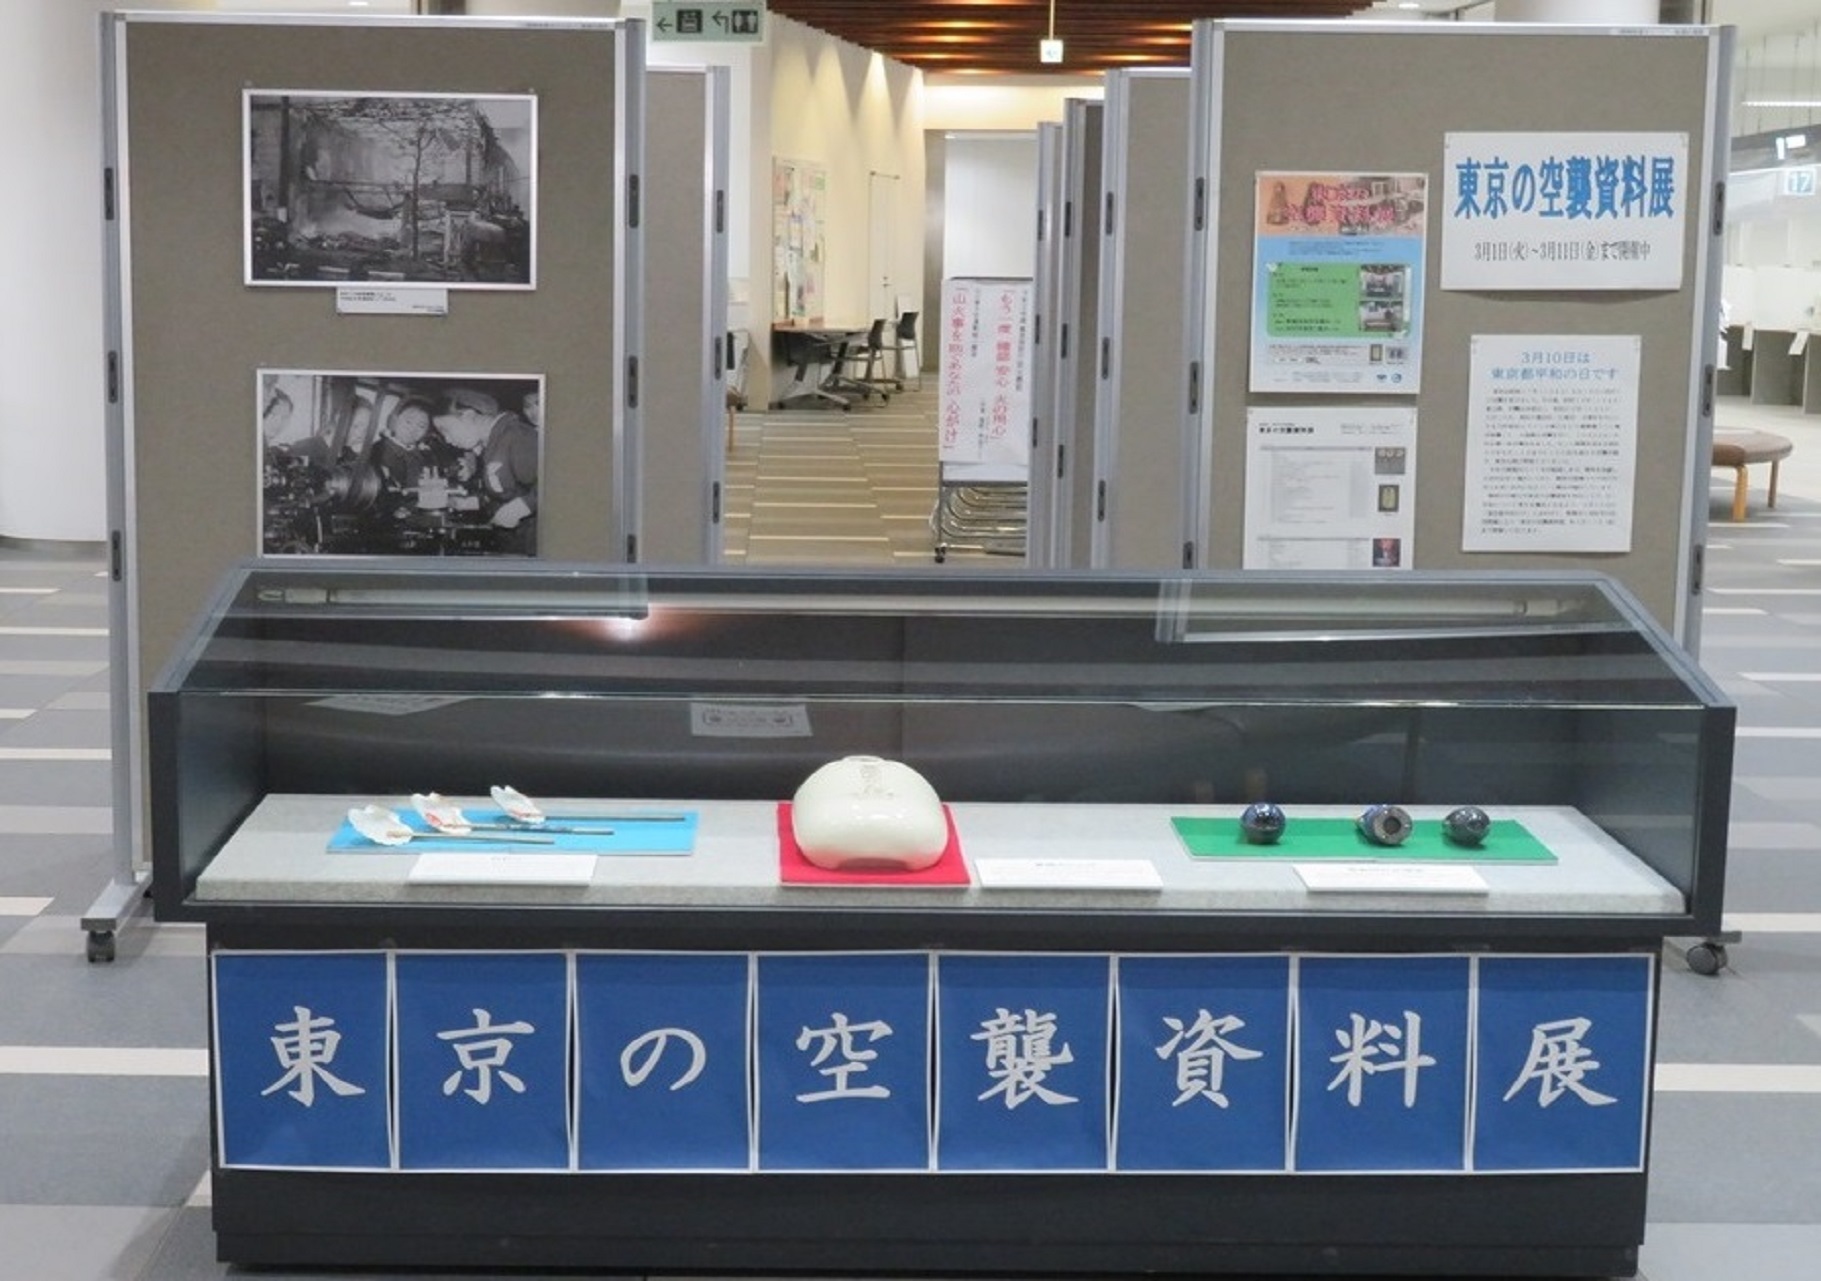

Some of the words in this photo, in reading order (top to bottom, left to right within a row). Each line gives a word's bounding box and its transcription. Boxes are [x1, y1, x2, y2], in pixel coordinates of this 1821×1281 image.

[1454, 155, 1675, 219] 東京の空襲資料展
[260, 1004, 1619, 1109] 東京の空襲資料展
